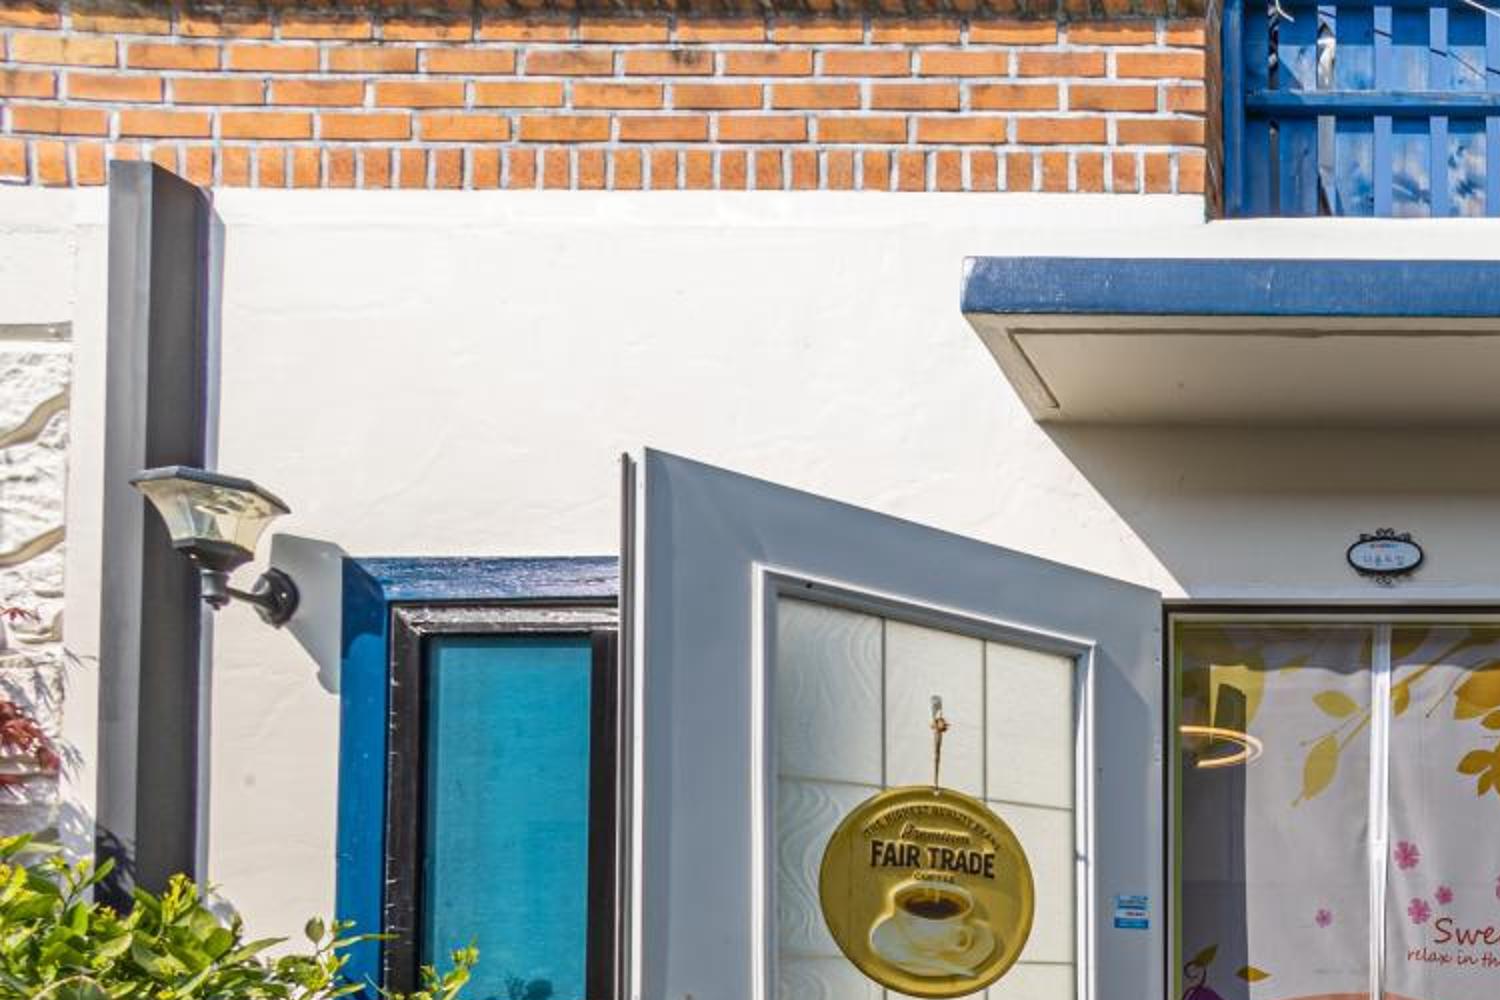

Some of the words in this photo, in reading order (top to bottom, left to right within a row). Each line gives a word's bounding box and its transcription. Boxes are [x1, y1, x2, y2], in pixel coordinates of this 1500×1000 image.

[870, 839, 921, 868] FAIR
[927, 846, 996, 880] TRADE
[1407, 948, 1453, 964] relax
[1456, 952, 1477, 965] in
